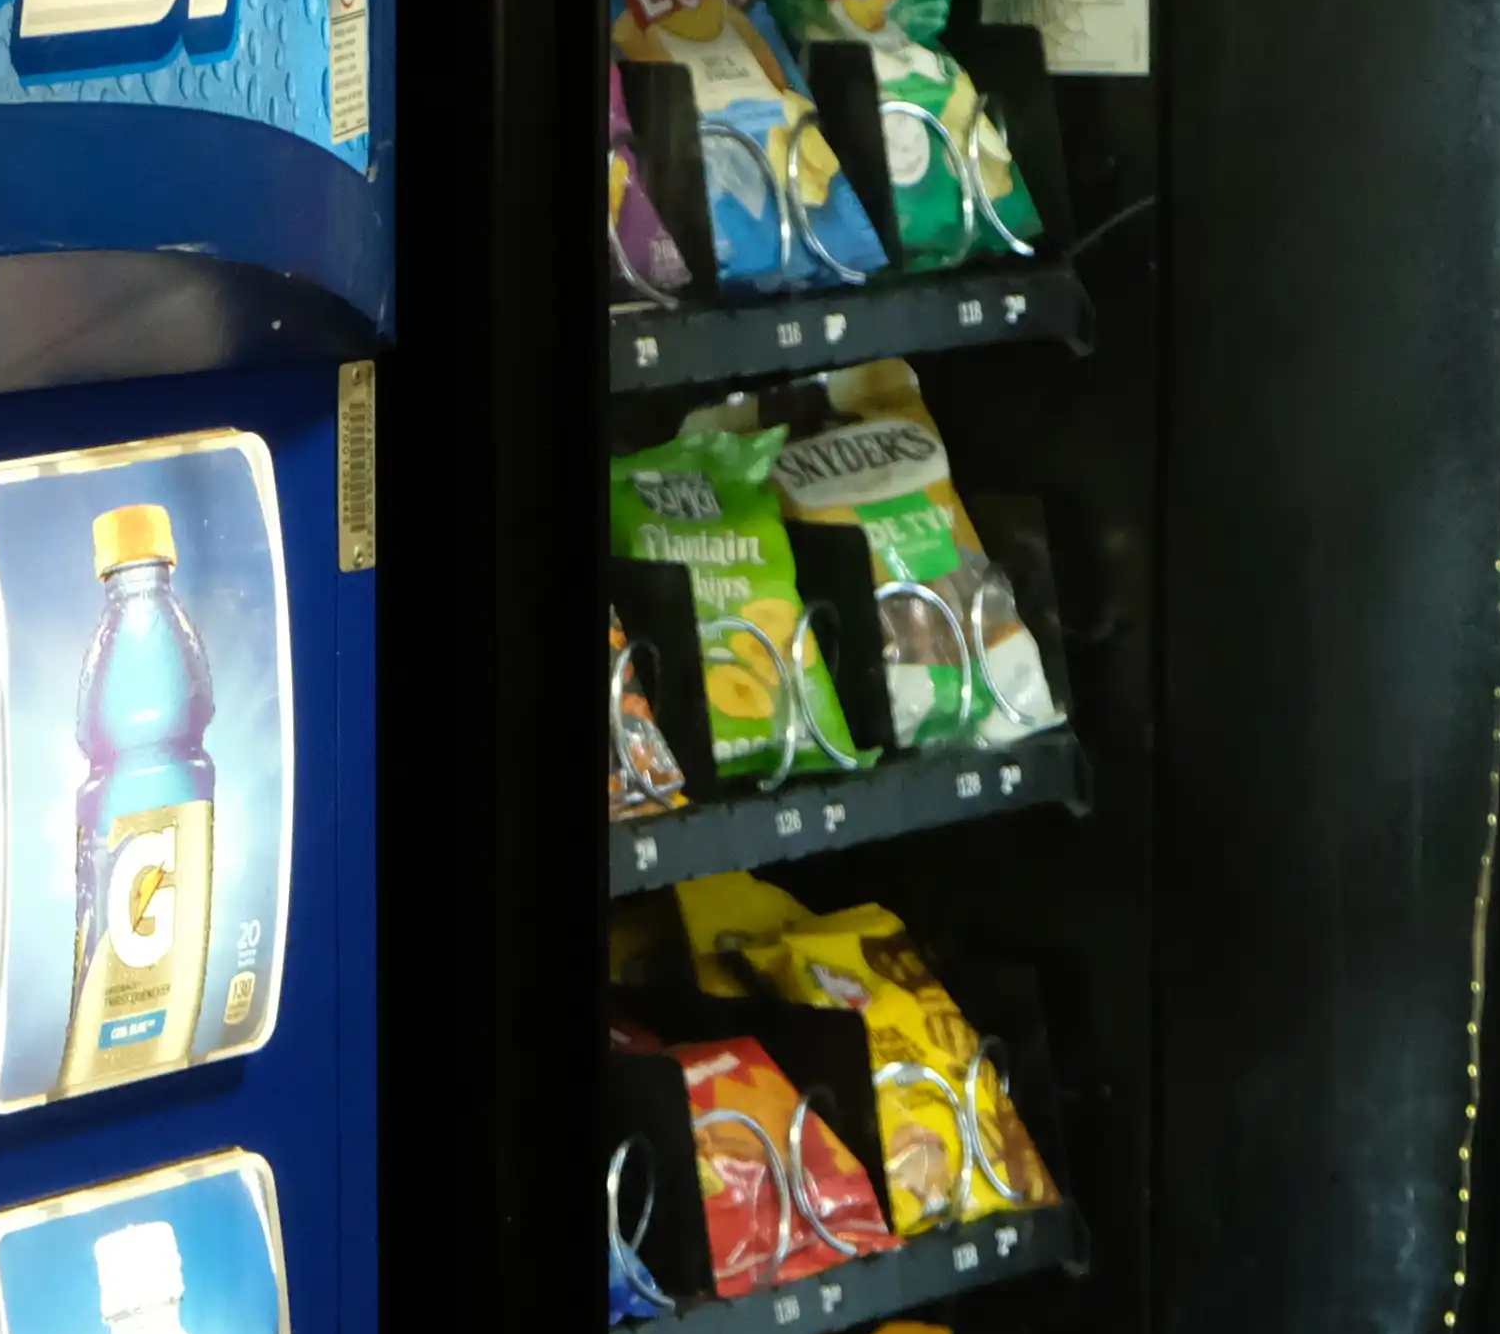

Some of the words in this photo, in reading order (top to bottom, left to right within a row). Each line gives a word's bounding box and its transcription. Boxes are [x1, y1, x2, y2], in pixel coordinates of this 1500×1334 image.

[778, 428, 938, 488] SNYDER'S
[690, 569, 752, 612] hips
[237, 919, 261, 949] 20
